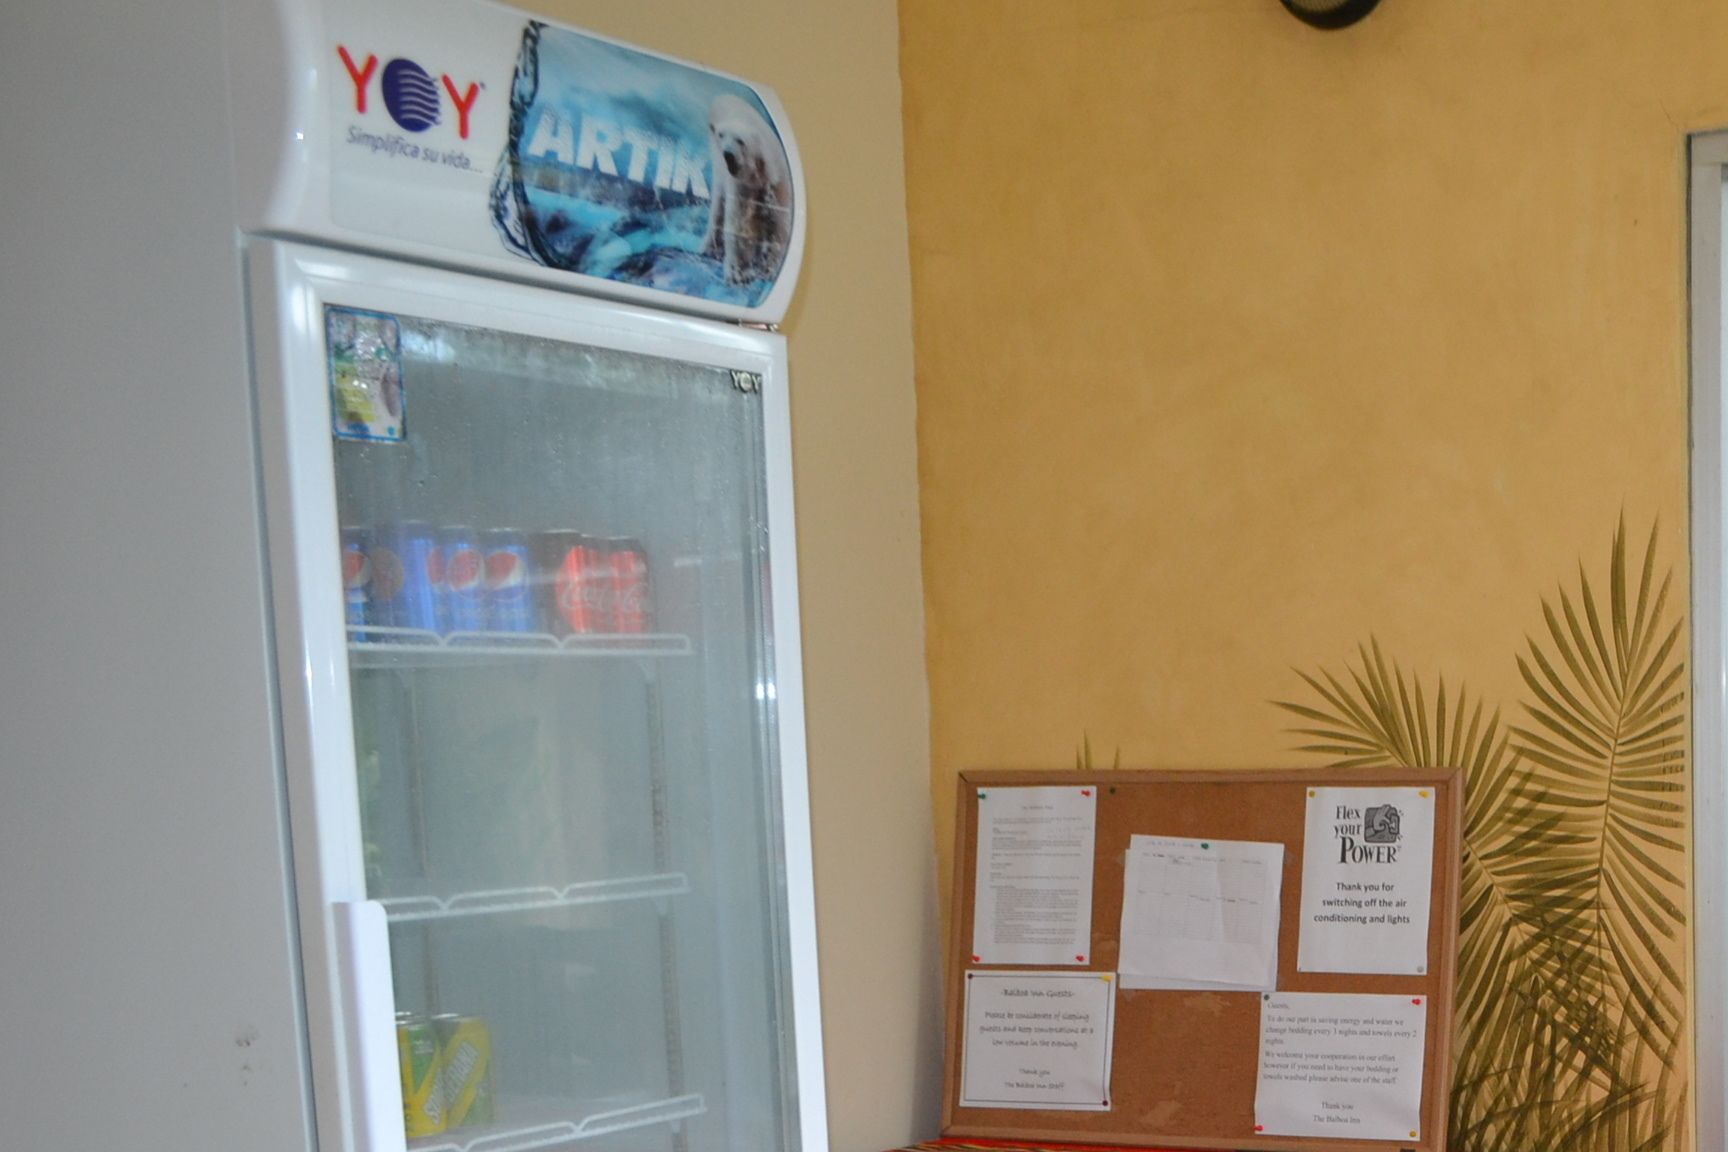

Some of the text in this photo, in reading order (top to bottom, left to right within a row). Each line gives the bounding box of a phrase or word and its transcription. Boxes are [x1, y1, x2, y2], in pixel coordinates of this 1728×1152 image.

[346, 124, 421, 159] Simplifica
[421, 147, 439, 163] su
[526, 107, 712, 202] ARTIK
[1335, 805, 1361, 820] Flex
[1334, 822, 1363, 839] your
[1338, 834, 1398, 865] POWER
[1335, 881, 1395, 894] Thank you for
[1322, 897, 1408, 909] switching off the air
[1313, 912, 1411, 925] conditioning and lights
